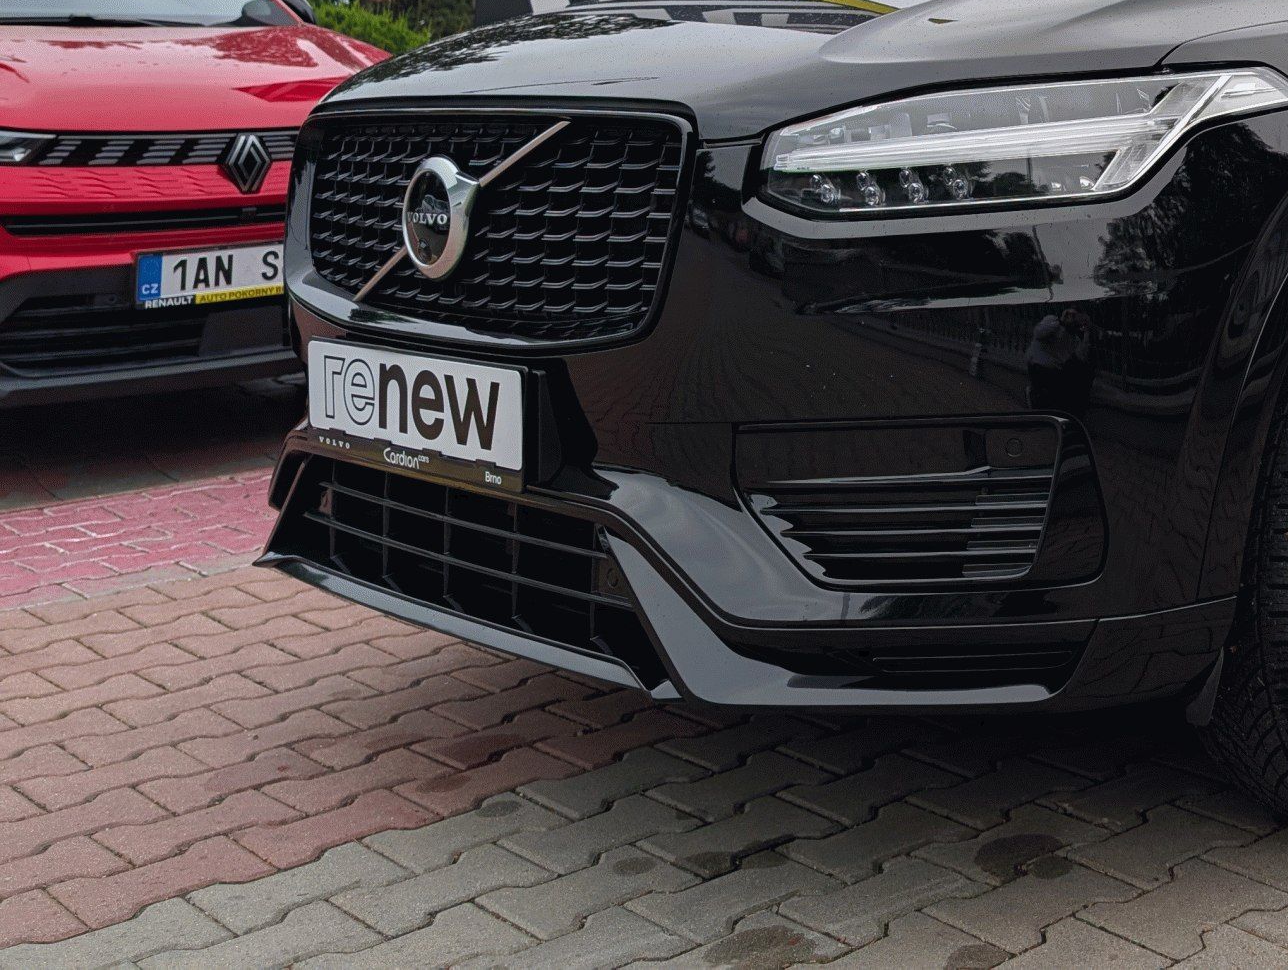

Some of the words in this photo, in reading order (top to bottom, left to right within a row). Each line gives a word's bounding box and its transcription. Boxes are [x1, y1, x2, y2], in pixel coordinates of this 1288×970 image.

[407, 212, 448, 224] VOLVO
[173, 254, 233, 291] 1AN
[261, 250, 280, 281] S
[142, 283, 159, 295] CZ
[144, 295, 194, 309] RENAULT
[200, 292, 227, 302] AUTO
[323, 354, 500, 451] renew
[383, 447, 420, 470] Cardion
[485, 471, 502, 485] Brno
